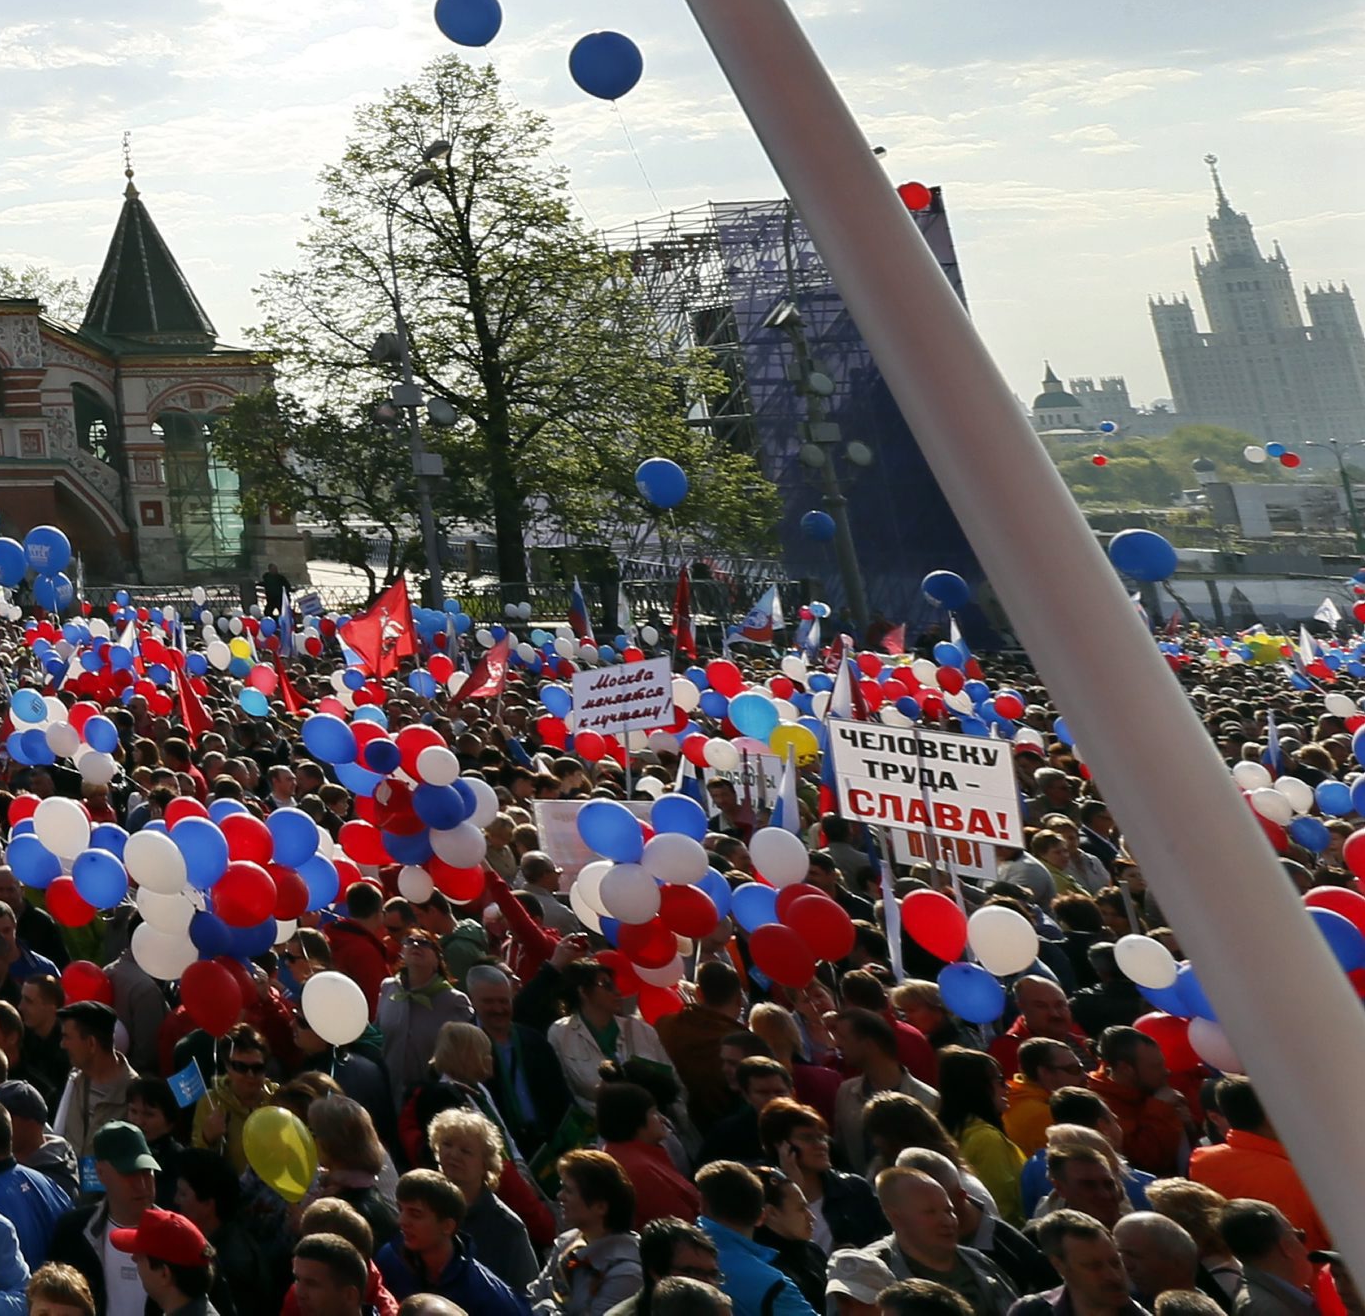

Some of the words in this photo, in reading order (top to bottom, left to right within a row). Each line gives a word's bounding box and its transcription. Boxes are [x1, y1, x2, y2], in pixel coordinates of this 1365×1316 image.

[590, 668, 654, 690] Москва
[581, 686, 665, 710] меняется
[838, 728, 999, 767] ЧЕЛОВЕКУ
[862, 759, 958, 793] ТРУДА
[847, 788, 1010, 840] СЛАВА!
